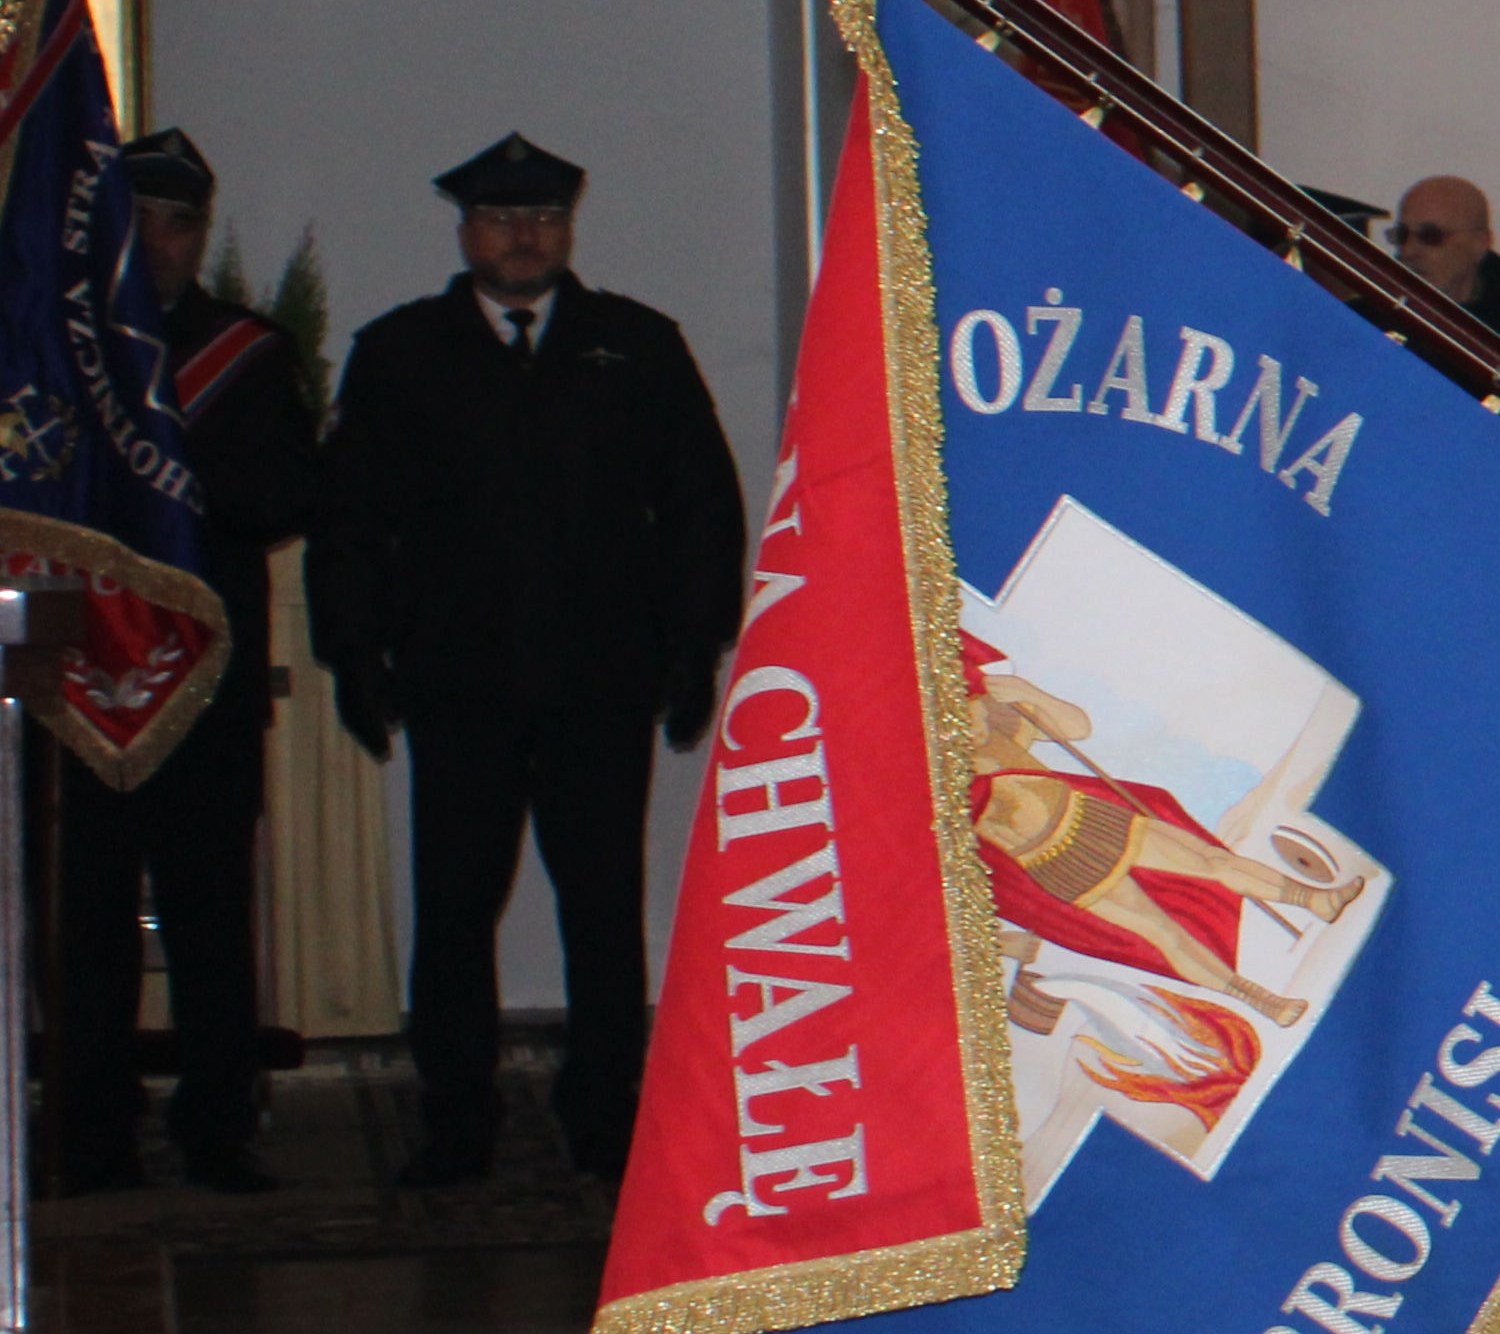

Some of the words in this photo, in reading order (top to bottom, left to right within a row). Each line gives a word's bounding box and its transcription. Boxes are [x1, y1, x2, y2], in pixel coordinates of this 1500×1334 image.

[62, 107, 120, 255] STRA
[951, 287, 1364, 517] OŻARNA
[703, 665, 868, 1225] CHWAŁĘ
